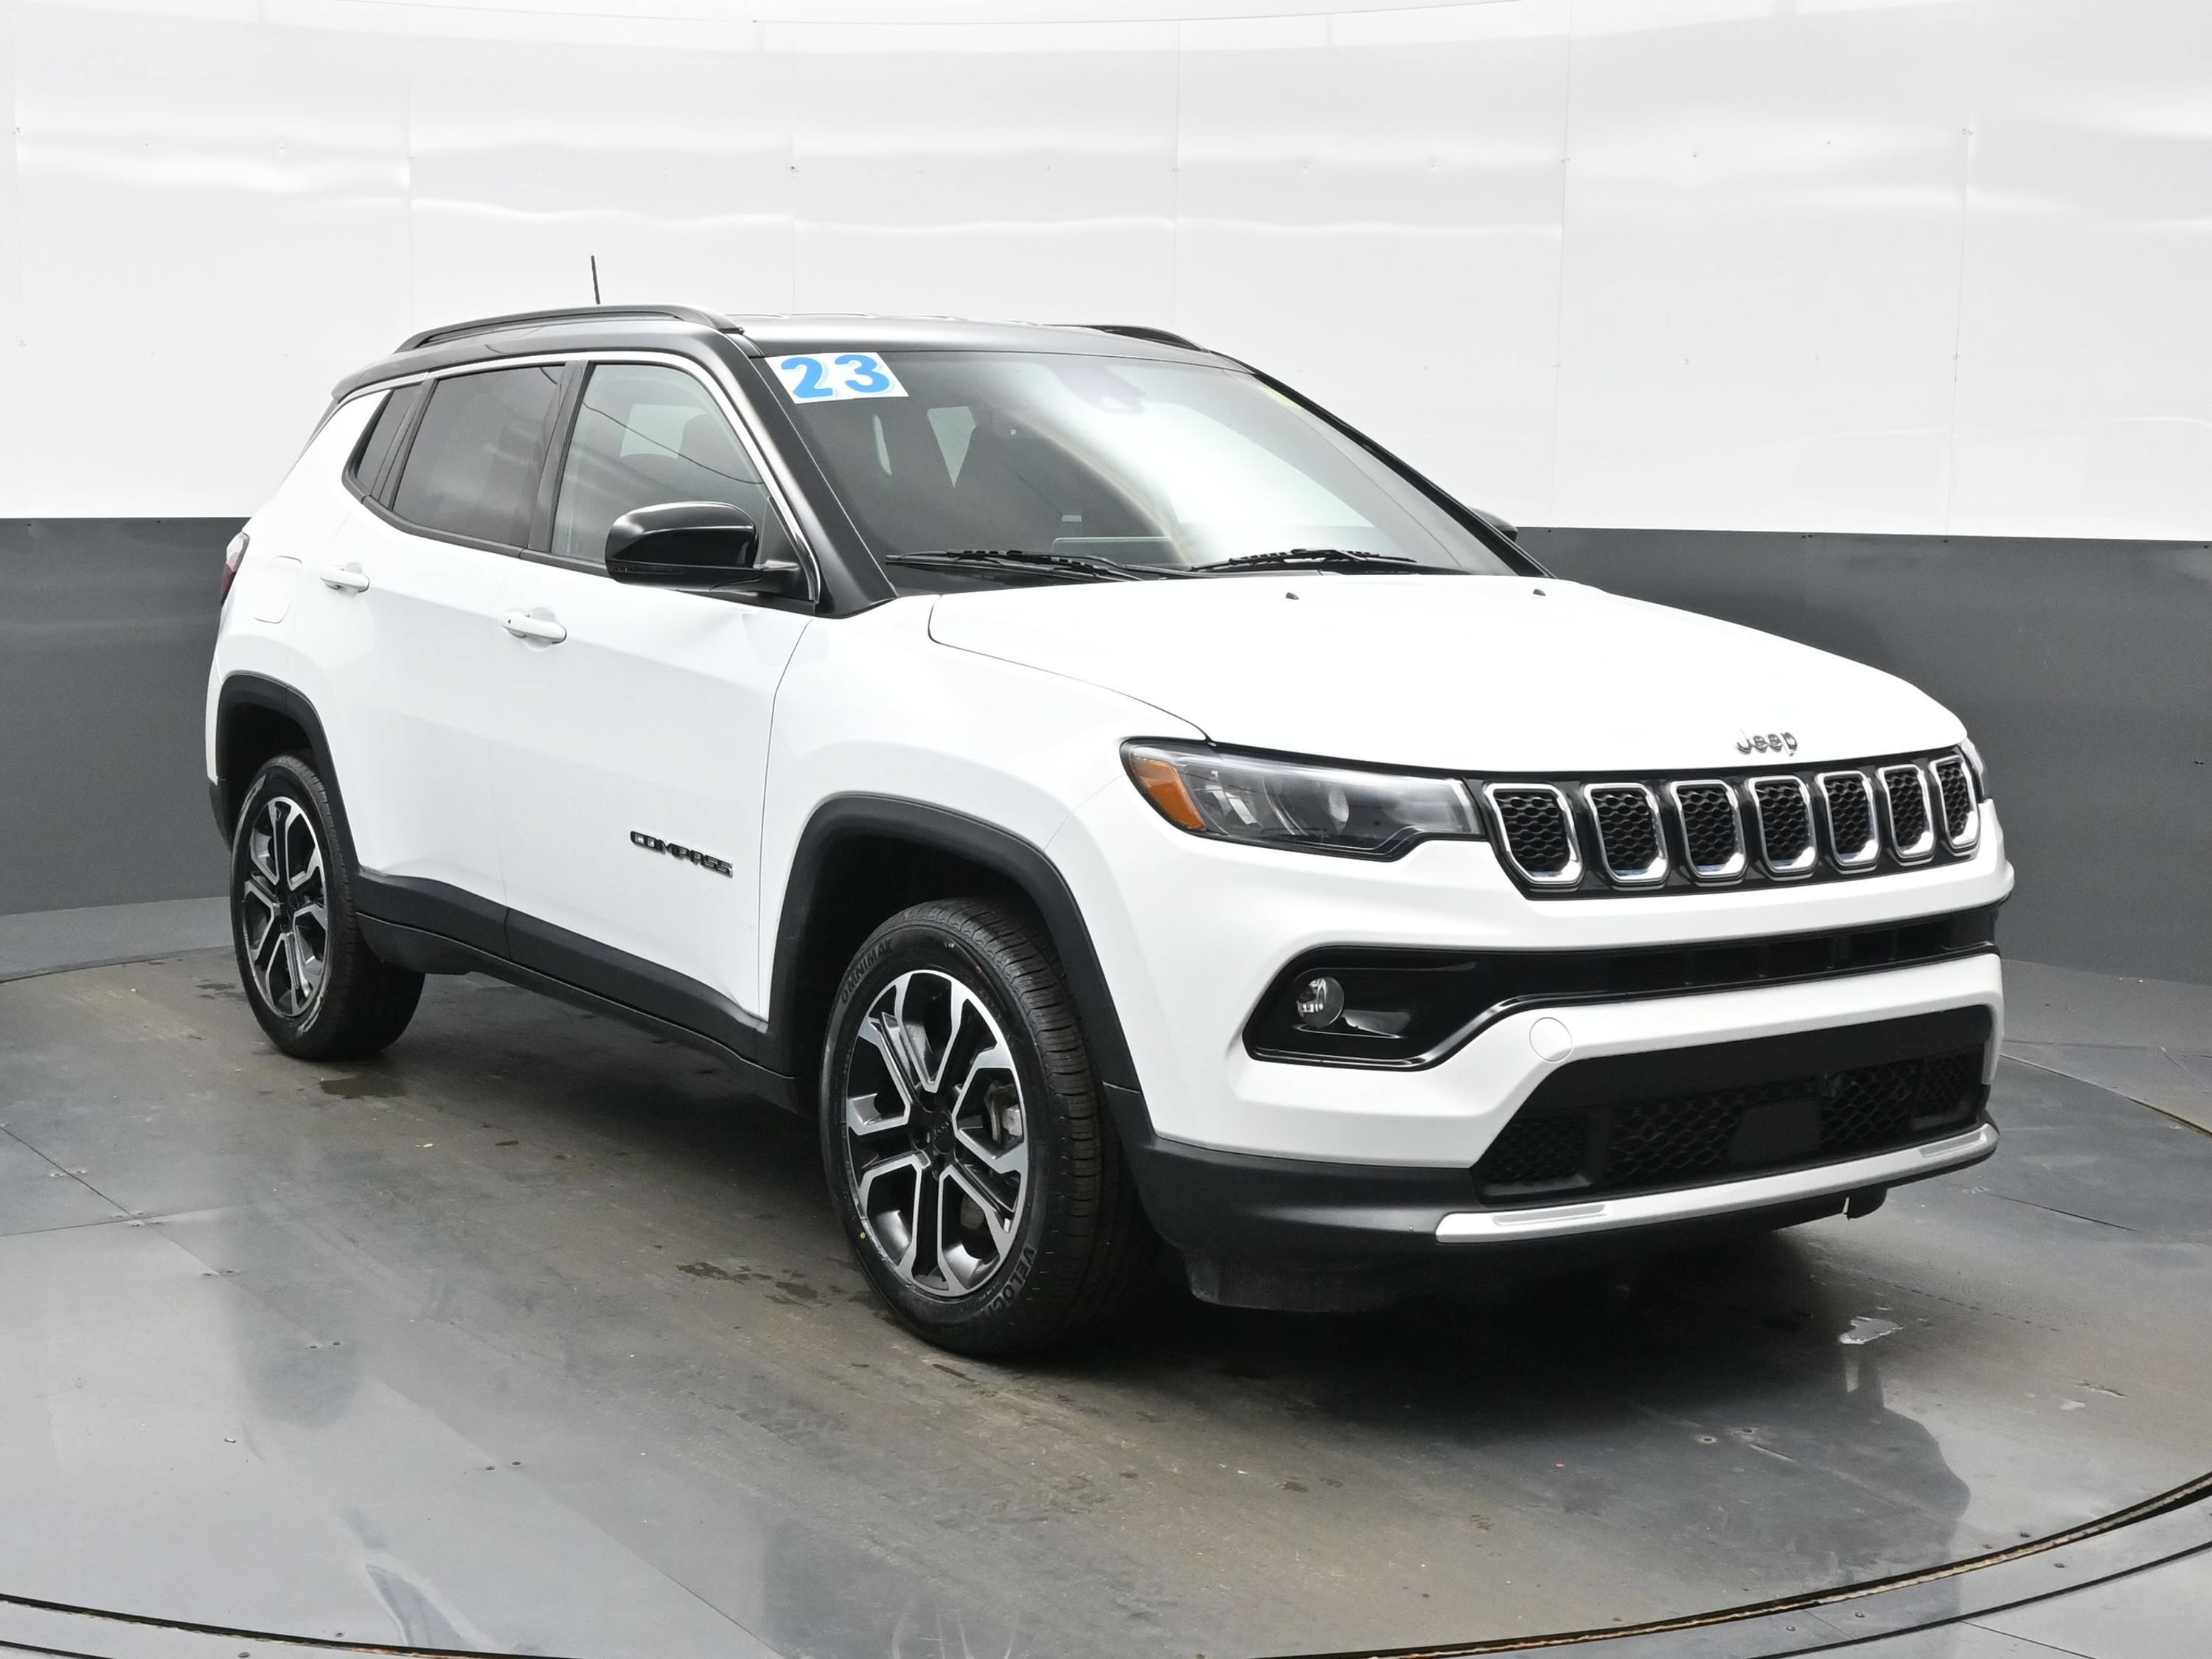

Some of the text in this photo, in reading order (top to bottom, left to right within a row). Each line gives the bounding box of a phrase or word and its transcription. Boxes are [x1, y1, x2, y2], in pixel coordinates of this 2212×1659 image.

[780, 354, 891, 399] 23
[1735, 729, 1798, 757] Jeep
[630, 831, 733, 878] COMPASS
